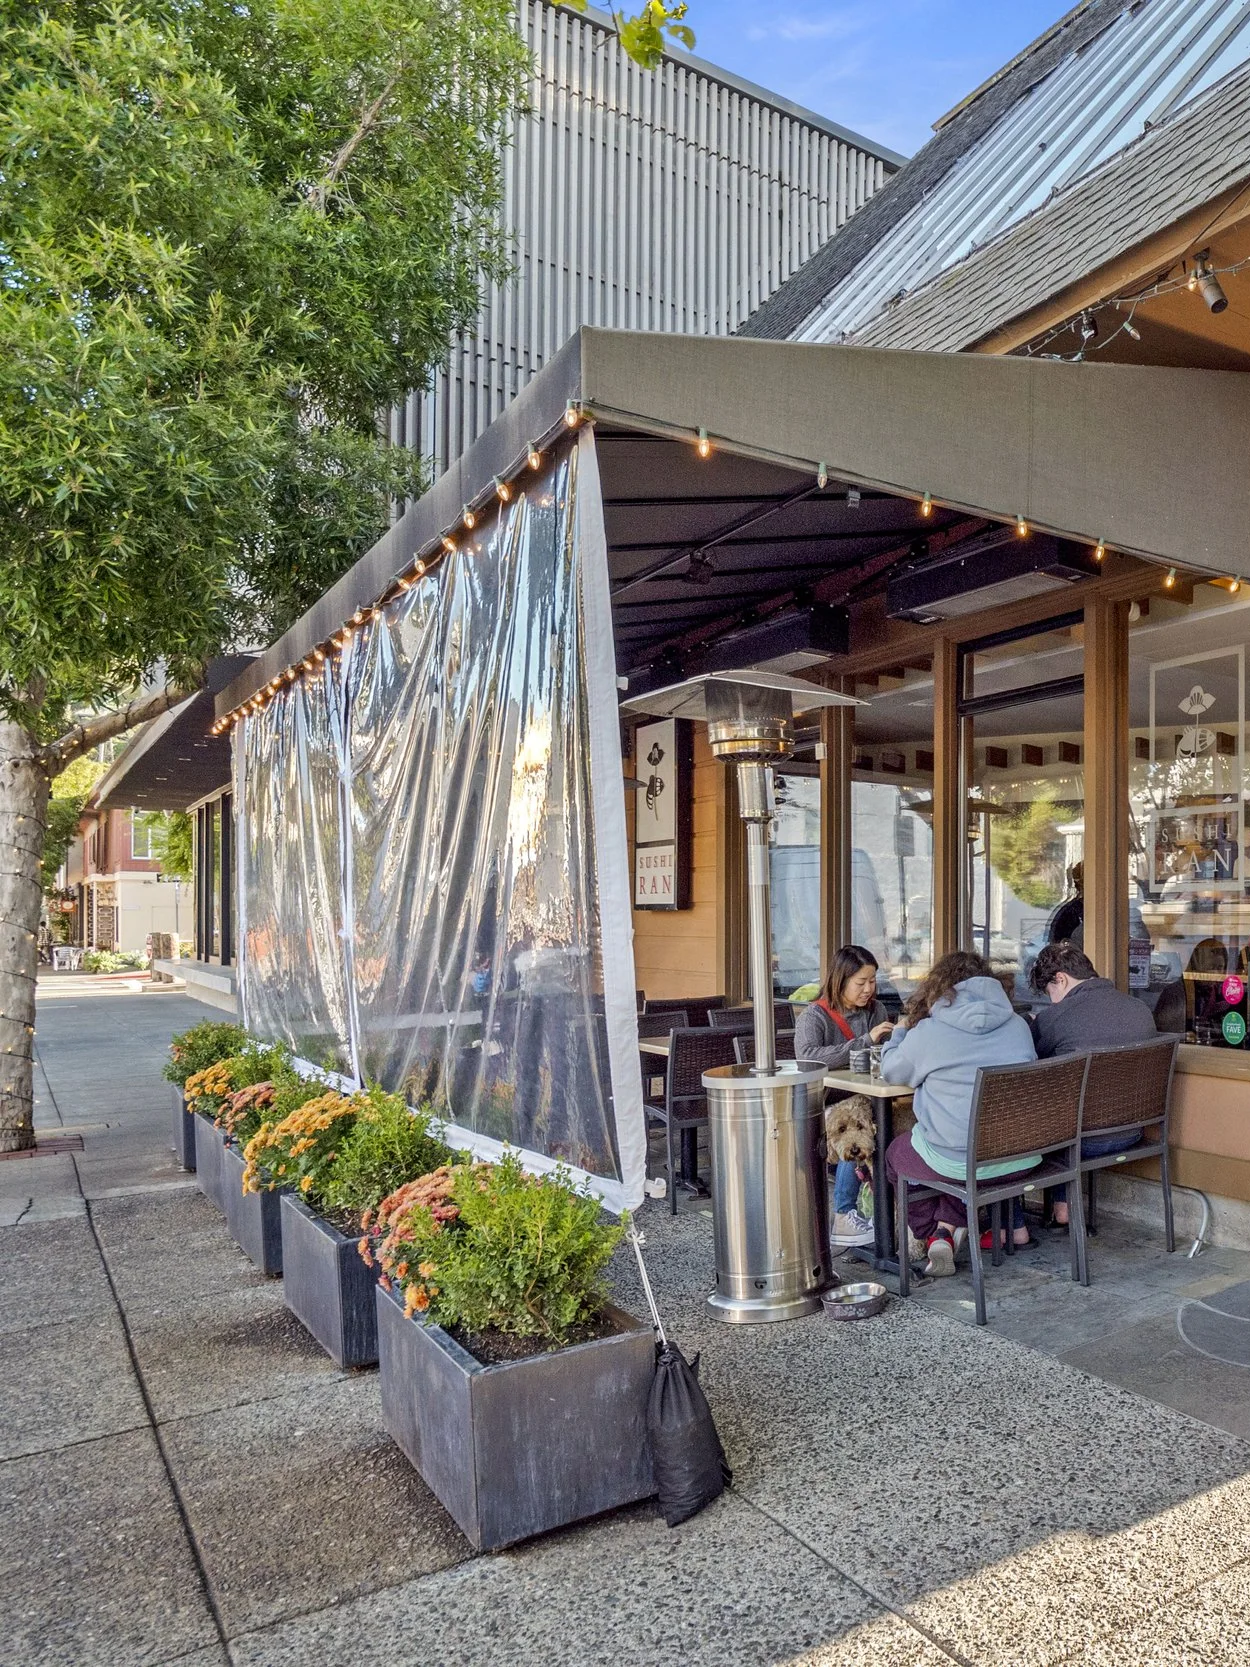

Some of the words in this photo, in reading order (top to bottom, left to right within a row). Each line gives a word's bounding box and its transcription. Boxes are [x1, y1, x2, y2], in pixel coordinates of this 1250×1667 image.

[1161, 823, 1233, 843] SUSHI
[639, 855, 672, 868] SUSHI
[1160, 848, 1232, 874] RAN
[639, 876, 672, 894] RAN
[1226, 1026, 1242, 1034] FAVE
